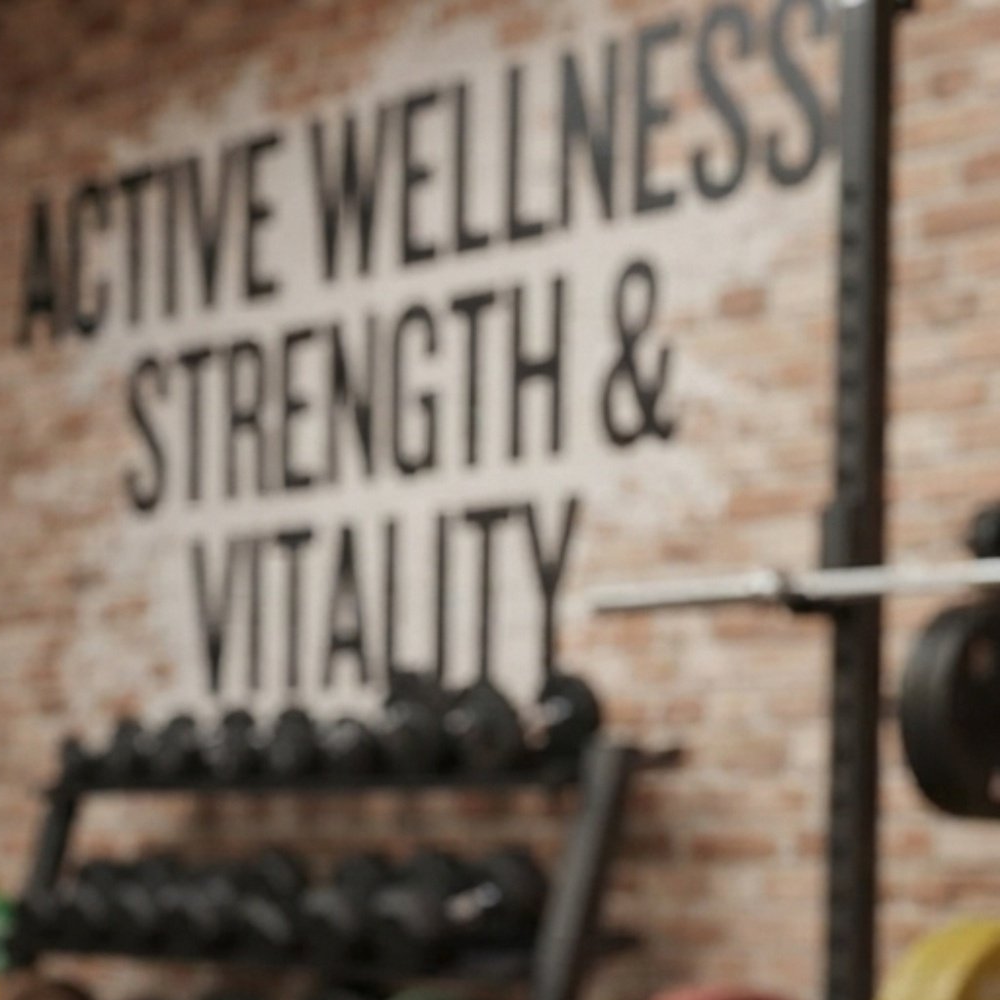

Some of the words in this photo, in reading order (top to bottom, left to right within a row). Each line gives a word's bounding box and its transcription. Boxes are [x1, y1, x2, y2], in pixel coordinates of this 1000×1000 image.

[15, 131, 282, 346] ACTIVE
[309, 0, 824, 283] WELLNESS
[124, 277, 566, 513] STRENGTH
[602, 260, 678, 448] &
[191, 497, 581, 692] VITALITY
